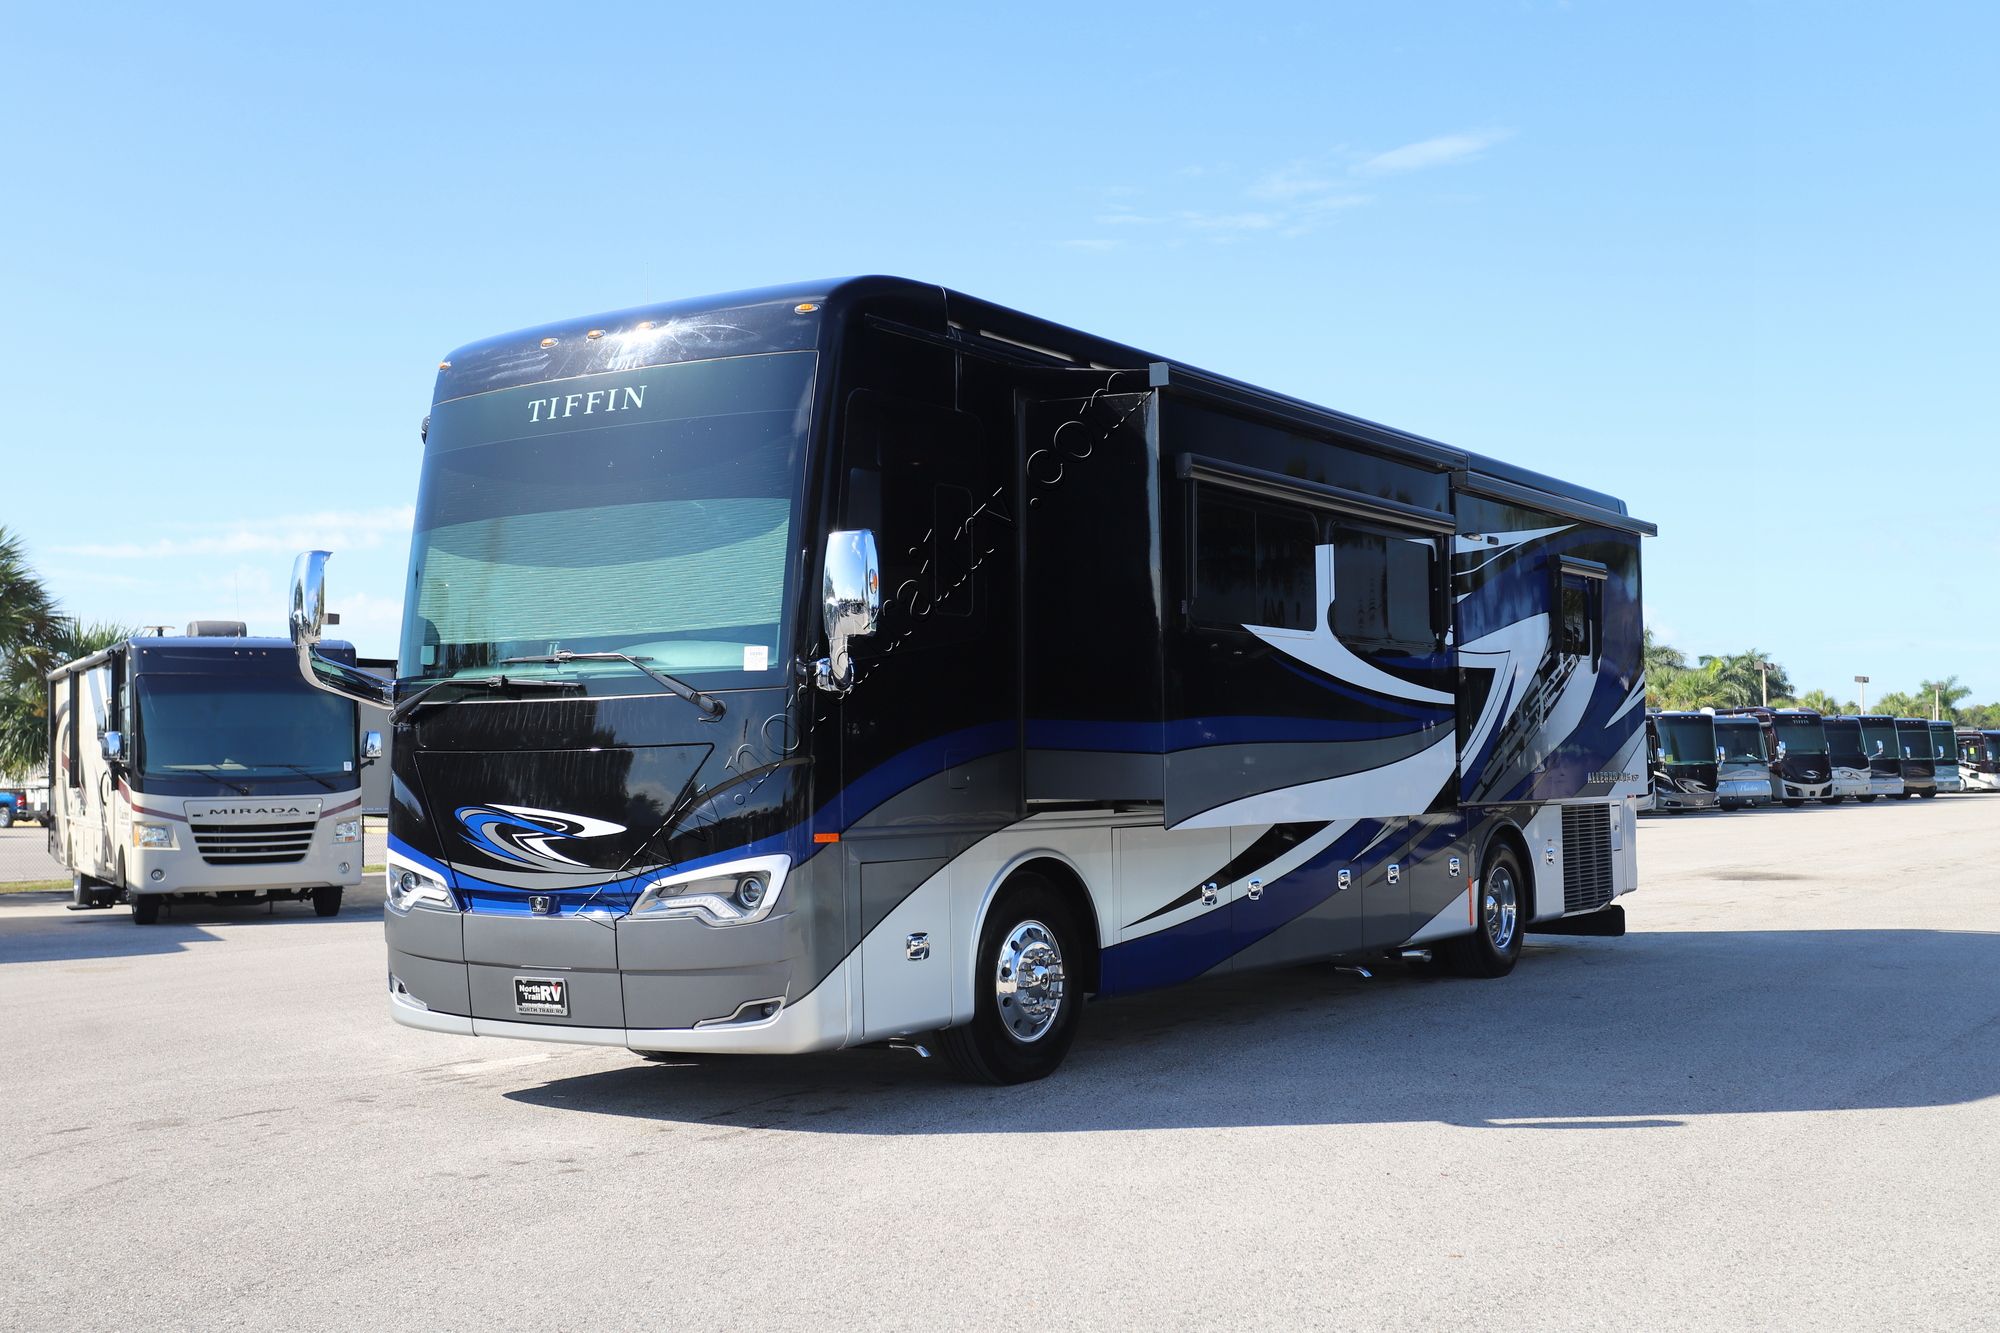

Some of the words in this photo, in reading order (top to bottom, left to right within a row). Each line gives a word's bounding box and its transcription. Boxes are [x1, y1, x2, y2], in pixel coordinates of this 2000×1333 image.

[527, 385, 648, 423] TIFFIN
[209, 807, 300, 815] MIRADA
[519, 984, 540, 993] North
[540, 985, 562, 1001] RV
